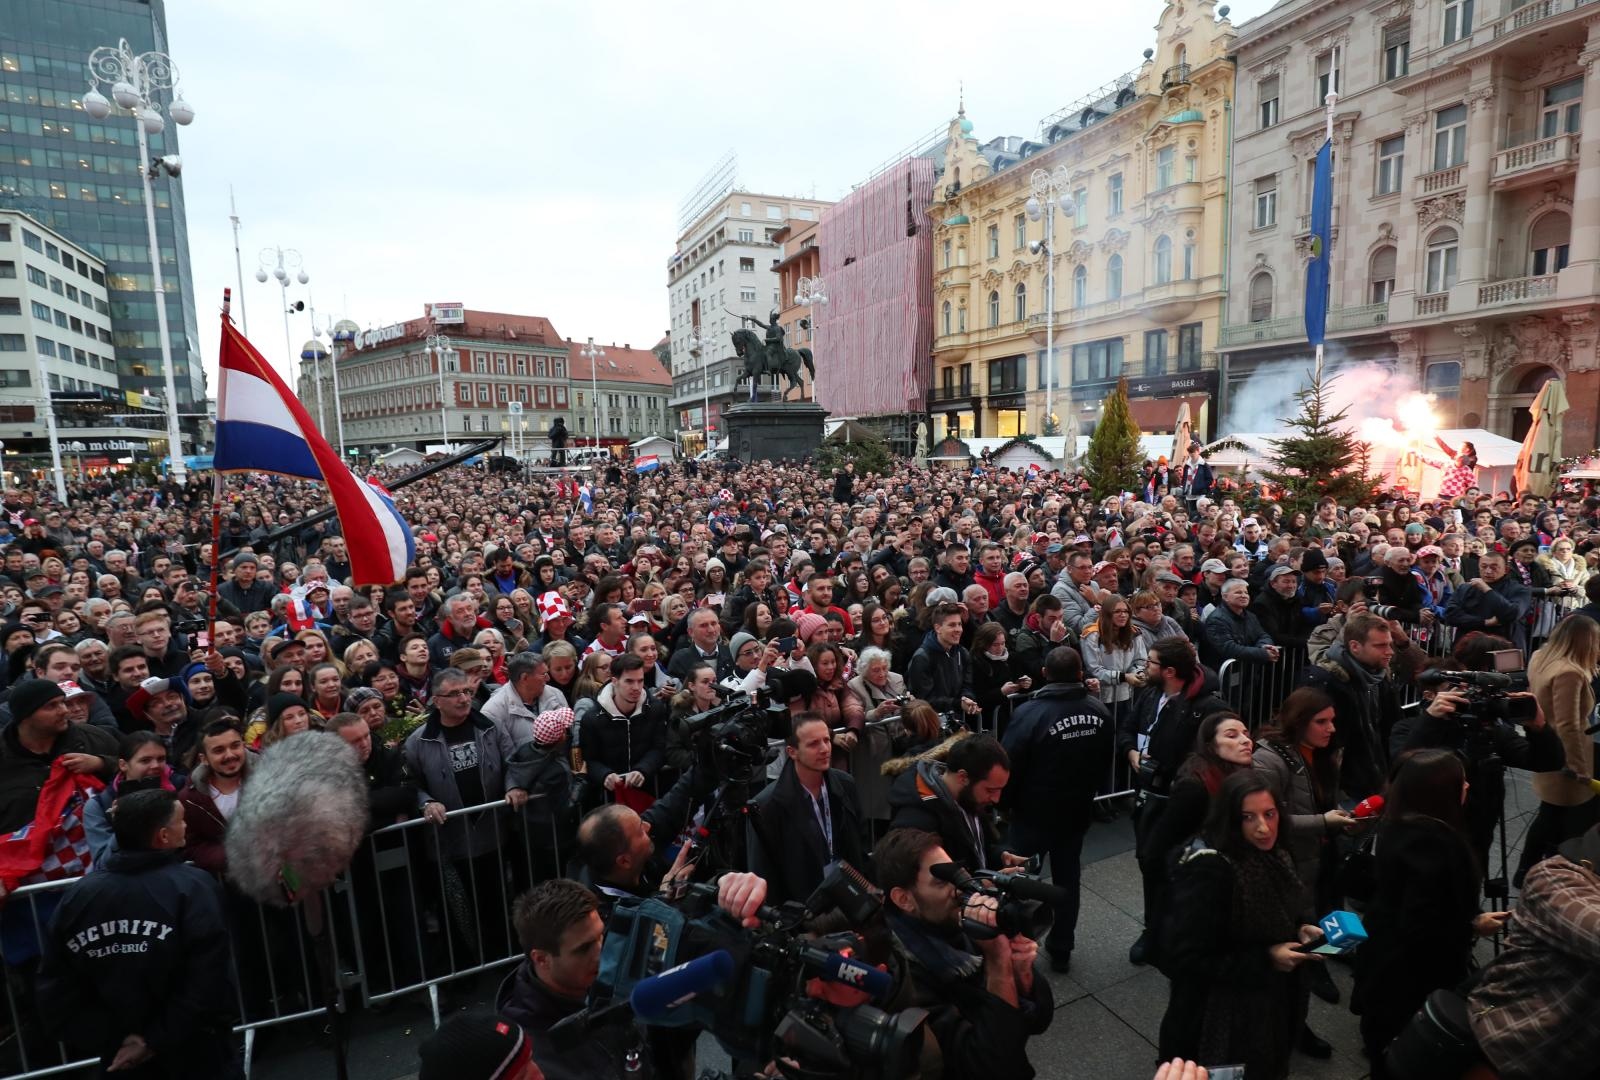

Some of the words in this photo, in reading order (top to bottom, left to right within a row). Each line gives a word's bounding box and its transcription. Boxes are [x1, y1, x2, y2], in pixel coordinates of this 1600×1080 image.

[1171, 379, 1195, 388] BASLER
[1049, 715, 1104, 735] SECURITY
[66, 919, 174, 953] SECURITY
[1324, 916, 1344, 940] Z1
[837, 962, 868, 985] HRT
